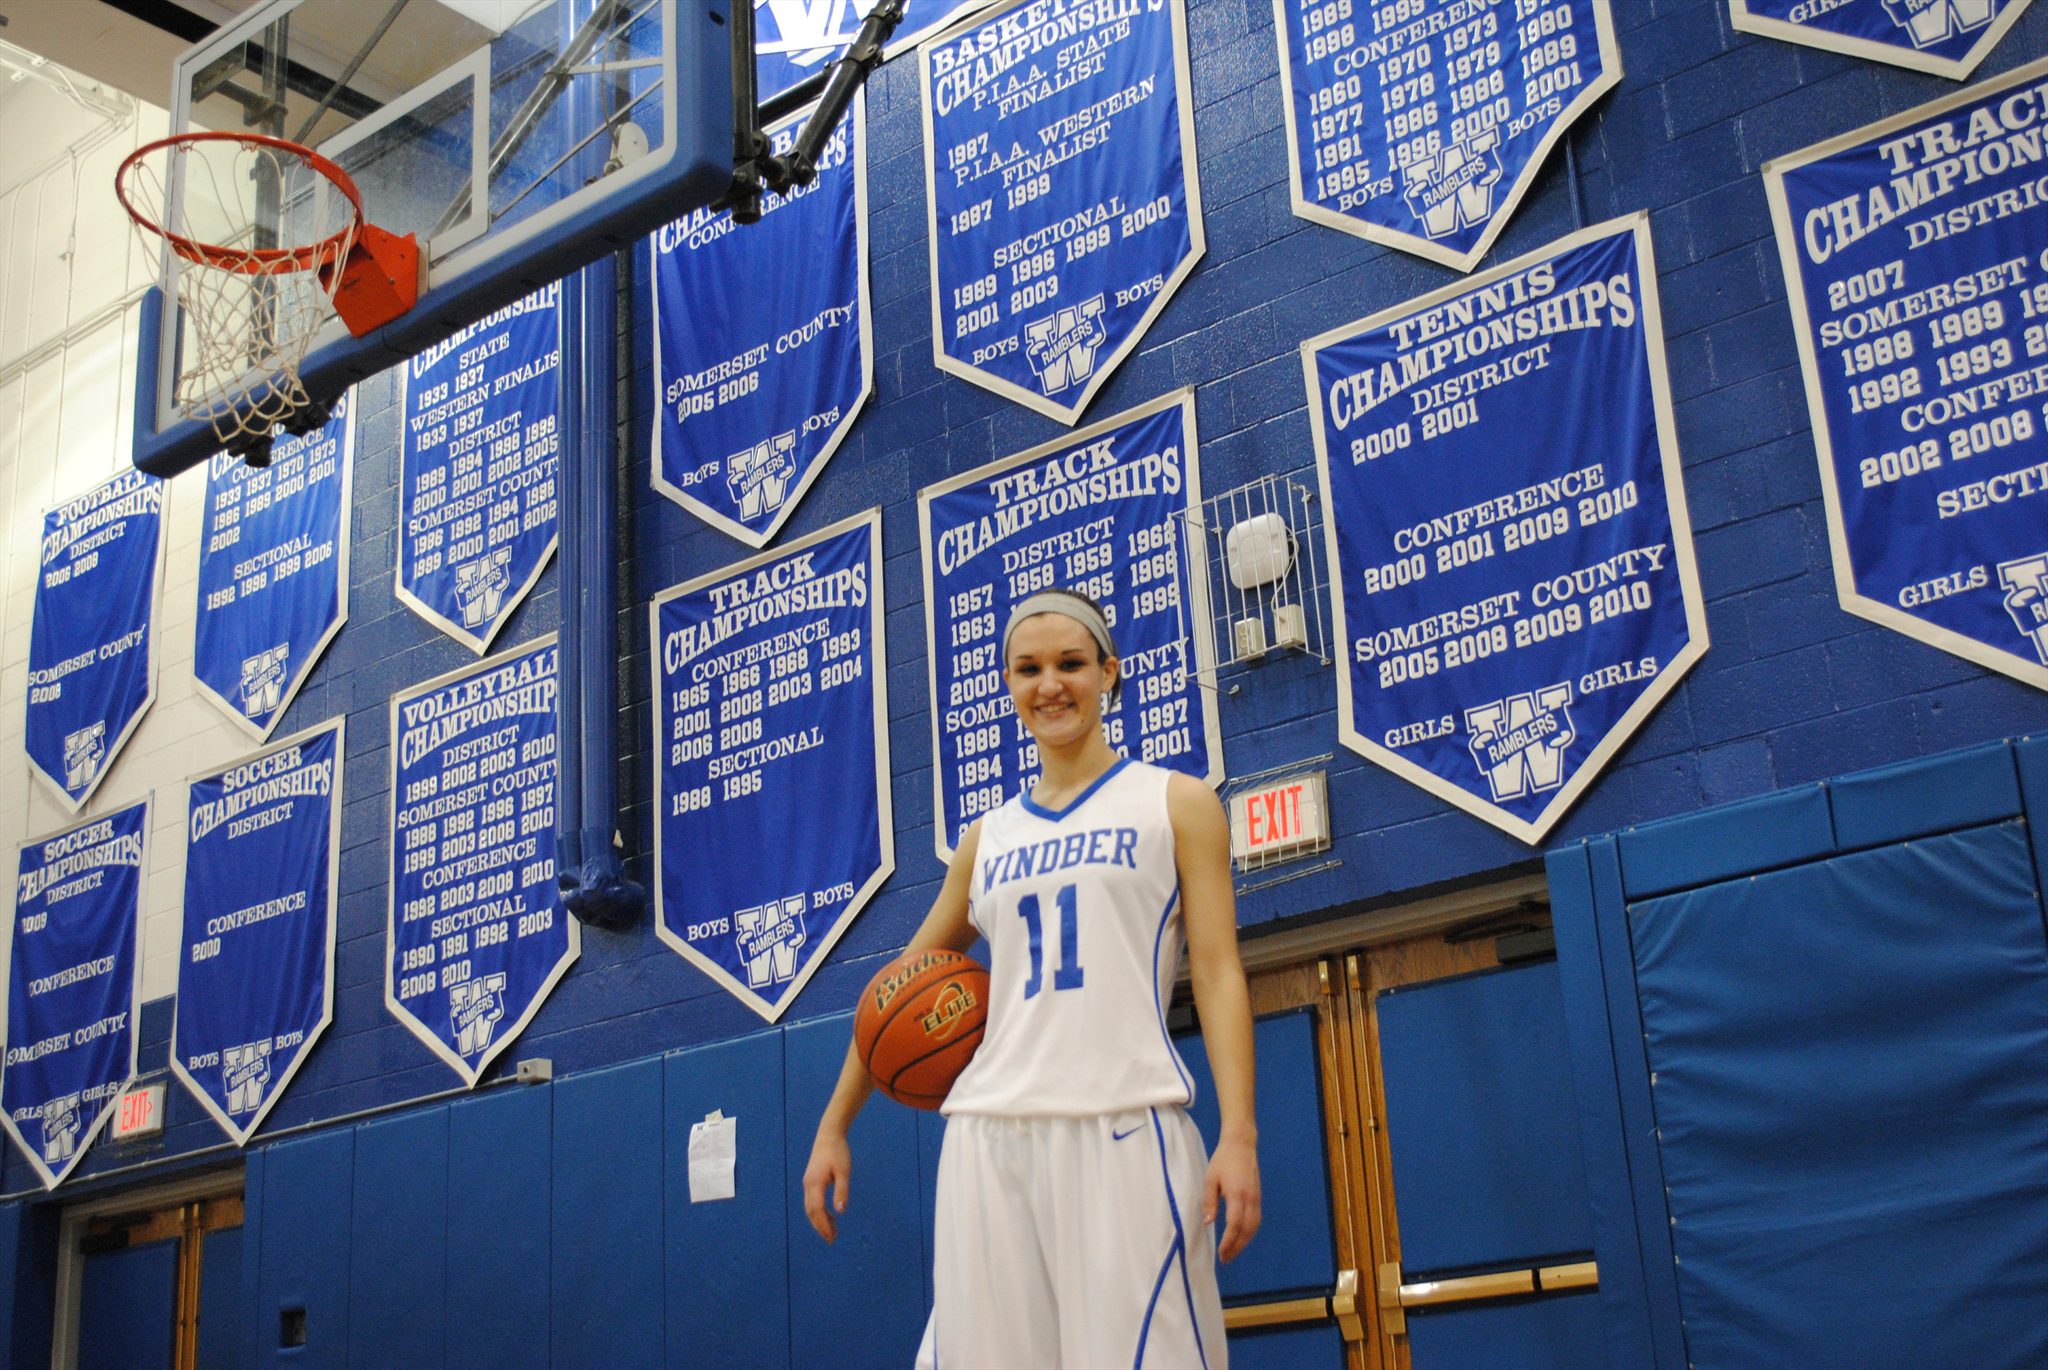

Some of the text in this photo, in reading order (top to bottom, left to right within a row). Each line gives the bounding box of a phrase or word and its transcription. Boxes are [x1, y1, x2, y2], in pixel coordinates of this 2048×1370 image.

[1305, 23, 1355, 65] 1998
[1334, 0, 1502, 77] CONFEREN
[1518, 4, 1572, 50] 1980
[973, 19, 1130, 111] P.I.A.A. STATE
[1447, 34, 1576, 85] 1979 1989
[998, 52, 1106, 121] FINALIST
[1451, 61, 1582, 115] 1988 2001
[955, 74, 1156, 188] P.I.A.A. WESTERN
[1451, 97, 1510, 143] 2000
[1507, 96, 1561, 140] BOYS
[949, 133, 989, 170] 1987
[1002, 122, 1111, 189] FINALIST
[1008, 173, 1050, 210] 1999
[1338, 177, 1393, 213] BOYS
[1423, 156, 1487, 208] RAMBLERS
[993, 196, 1126, 269] SECTIONAL
[1122, 195, 1170, 238] 2000
[1011, 275, 1058, 315] 2003
[1115, 274, 1164, 308] BOYS
[1389, 263, 1556, 352] TENNIS
[1820, 256, 2027, 348] SOMERSET
[1828, 260, 1904, 311] 2007
[460, 332, 509, 370] STATE
[667, 301, 854, 404] SOMERSET COUNTY
[972, 335, 1018, 366] BOYS
[1041, 321, 1093, 366] RAMBLERS
[1330, 272, 1635, 430] CHAMPIONSHIPS
[1842, 300, 2004, 376] 1988 1989
[410, 350, 559, 432] WESTERN FINALIS
[455, 364, 484, 393] 1937
[1411, 343, 1550, 415] DISTRICT
[1849, 338, 2012, 413] 1992 1993
[678, 372, 759, 424] 2005 2006
[1422, 399, 1478, 441] 2001
[449, 411, 521, 459] DISTRICT
[454, 407, 483, 436] 1937
[802, 407, 839, 437] BOYS
[247, 438, 336, 496] 1937 1970 1973
[453, 449, 483, 478] 1994
[488, 451, 521, 483] 2002
[1860, 409, 2032, 488] 2002 2008
[245, 458, 335, 517] 1989 2000 2001
[526, 479, 554, 509] 1998
[682, 461, 719, 486] BOYS
[741, 454, 785, 494] RAMBLERS
[990, 436, 1117, 509] TRACK
[57, 471, 146, 527] FOOTBALL
[409, 486, 496, 538] SOMERSET
[524, 499, 557, 531] 2002
[938, 446, 1181, 576] CHAMPIONSHIPS
[1393, 463, 1604, 553] CONFERENCE
[1579, 480, 1638, 527] 2010
[42, 480, 161, 567] CHAMPIONSHIPS
[70, 522, 126, 560] DISTRICT
[210, 526, 240, 552] 2002
[1002, 516, 1114, 574] DISTRICT
[46, 552, 98, 588] 2006 2008
[234, 533, 311, 580] SECTIONAL
[1065, 543, 1112, 579] 1959
[207, 555, 300, 611] 1992 1998 1999
[466, 568, 502, 603] RAMBLERS
[709, 552, 815, 614] TRACK
[1355, 544, 1666, 662] SOMERSET COUNTY
[1590, 581, 1651, 625] 2010
[1899, 566, 1988, 608] GIRLS
[664, 562, 866, 675] CHAMPIONSHIPS
[952, 613, 995, 647] 1963
[692, 618, 830, 683] CONFERENCE
[822, 628, 860, 662] 1993
[953, 643, 996, 678] 1967
[29, 650, 96, 686] SOMERSET
[249, 663, 281, 695] RAMBLERS
[769, 655, 861, 707] 2003 2004
[950, 670, 999, 706] 2000
[1579, 657, 1658, 695] GIRLS
[31, 683, 62, 704] 2008
[402, 678, 558, 770] CHAMPIONSHIP
[443, 724, 519, 767] DISTRICT
[956, 725, 1000, 758] 1988
[958, 698, 1188, 788] 1994 1997
[1141, 727, 1191, 763] 2001
[1384, 715, 1454, 749] GIRLS
[1488, 714, 1557, 763] RAMBLERS
[71, 738, 98, 767] RAMBLERS
[223, 746, 302, 794] SOCCER
[523, 733, 555, 763] 2010
[672, 734, 712, 766] 2006
[708, 727, 824, 780] SECTIONAL
[192, 758, 332, 844] CHAMPIONSHIPS
[398, 782, 488, 829] SOMERSET
[522, 782, 553, 811] 1997
[724, 770, 762, 801] 1995
[228, 802, 293, 840] DISTRICT
[521, 806, 554, 836] 2010
[1247, 785, 1302, 846] EXIT
[45, 819, 114, 863] SOCCER
[984, 828, 1138, 895] WINDBER
[19, 831, 141, 905] CHAMPIONSHIPS
[423, 838, 536, 889] CONFERENCE
[522, 859, 554, 888] 2010
[47, 870, 104, 906] DISTRICT
[813, 882, 854, 908] BOYS
[208, 891, 305, 936] CONFERENCE
[431, 895, 526, 939] SECTIONAL
[519, 908, 553, 938] 2003
[687, 918, 729, 941] BOYS
[192, 937, 220, 962] 2000
[748, 919, 794, 957] RAMBLERS
[1017, 883, 1083, 1000] 11
[442, 960, 471, 988] 2010
[876, 952, 962, 1014] Baden
[459, 994, 494, 1029] RAMBLERS
[922, 990, 976, 1034] ELITE
[7, 1012, 127, 1066] SOMERSET COUNTY
[189, 1052, 219, 1070] BOYS
[275, 1030, 303, 1050] BOYS
[82, 1081, 118, 1102] GIRLS
[230, 1059, 264, 1088] RAMBLERS
[121, 1091, 149, 1132] EXIT
